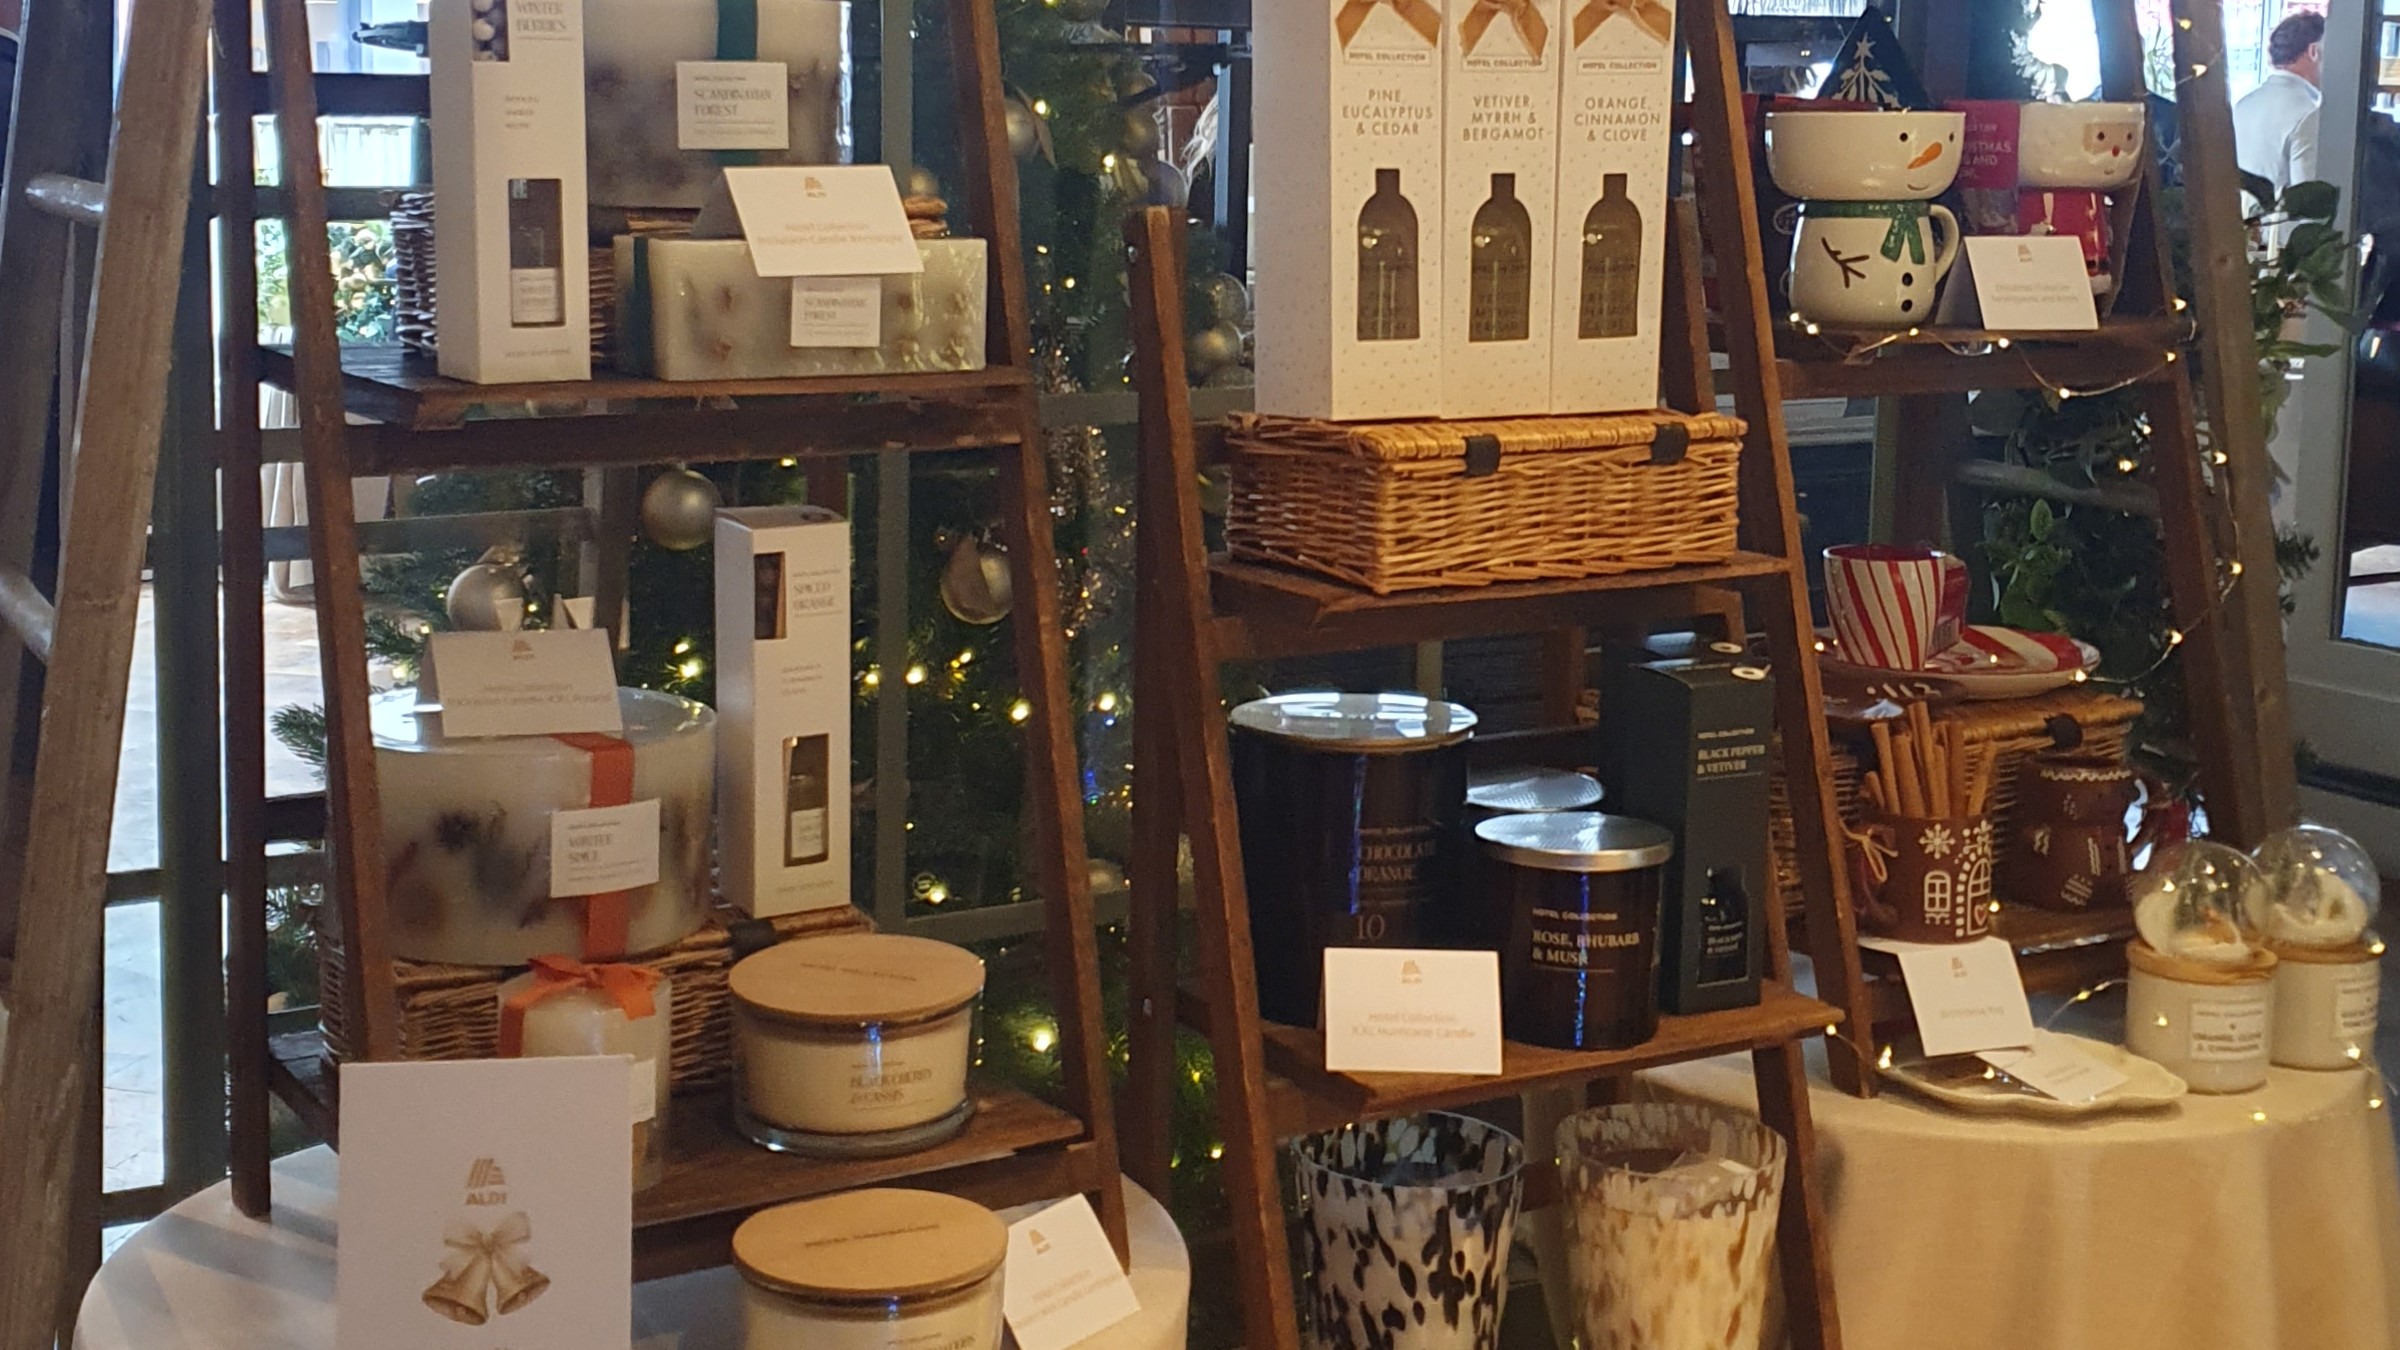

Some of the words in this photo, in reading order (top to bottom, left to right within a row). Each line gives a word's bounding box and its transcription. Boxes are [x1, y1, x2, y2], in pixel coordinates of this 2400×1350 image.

[1348, 51, 1373, 61] HOTEL
[1375, 51, 1427, 62] COLLECTION
[1581, 61, 1606, 70] HOTEL
[1607, 61, 1658, 70] COLLECTION
[1341, 104, 1434, 121] EUCALYPTUS
[1470, 110, 1521, 125] MYRRH
[1526, 110, 1537, 125] &
[1572, 111, 1661, 127] CINNAMON
[1355, 121, 1366, 136] &
[1370, 121, 1420, 137] CEDAR
[1461, 126, 1544, 142] BERGAMOT
[1586, 128, 1597, 143] &
[1602, 128, 1649, 142] CLOVE
[1697, 747, 1729, 761] BLACK
[1730, 744, 1766, 758] PEPPER
[1696, 764, 1705, 775] &
[1706, 760, 1748, 773] VETIVER
[1532, 907, 1560, 920] HOTEL
[1562, 910, 1618, 921] COLLECTION
[1356, 914, 1386, 941] 10
[1532, 929, 1573, 948] ROSE,
[1577, 931, 1640, 948] RHUBARB
[1532, 946, 1543, 961] &
[1546, 949, 1588, 967] MUSK
[465, 1191, 507, 1206] ALDI
